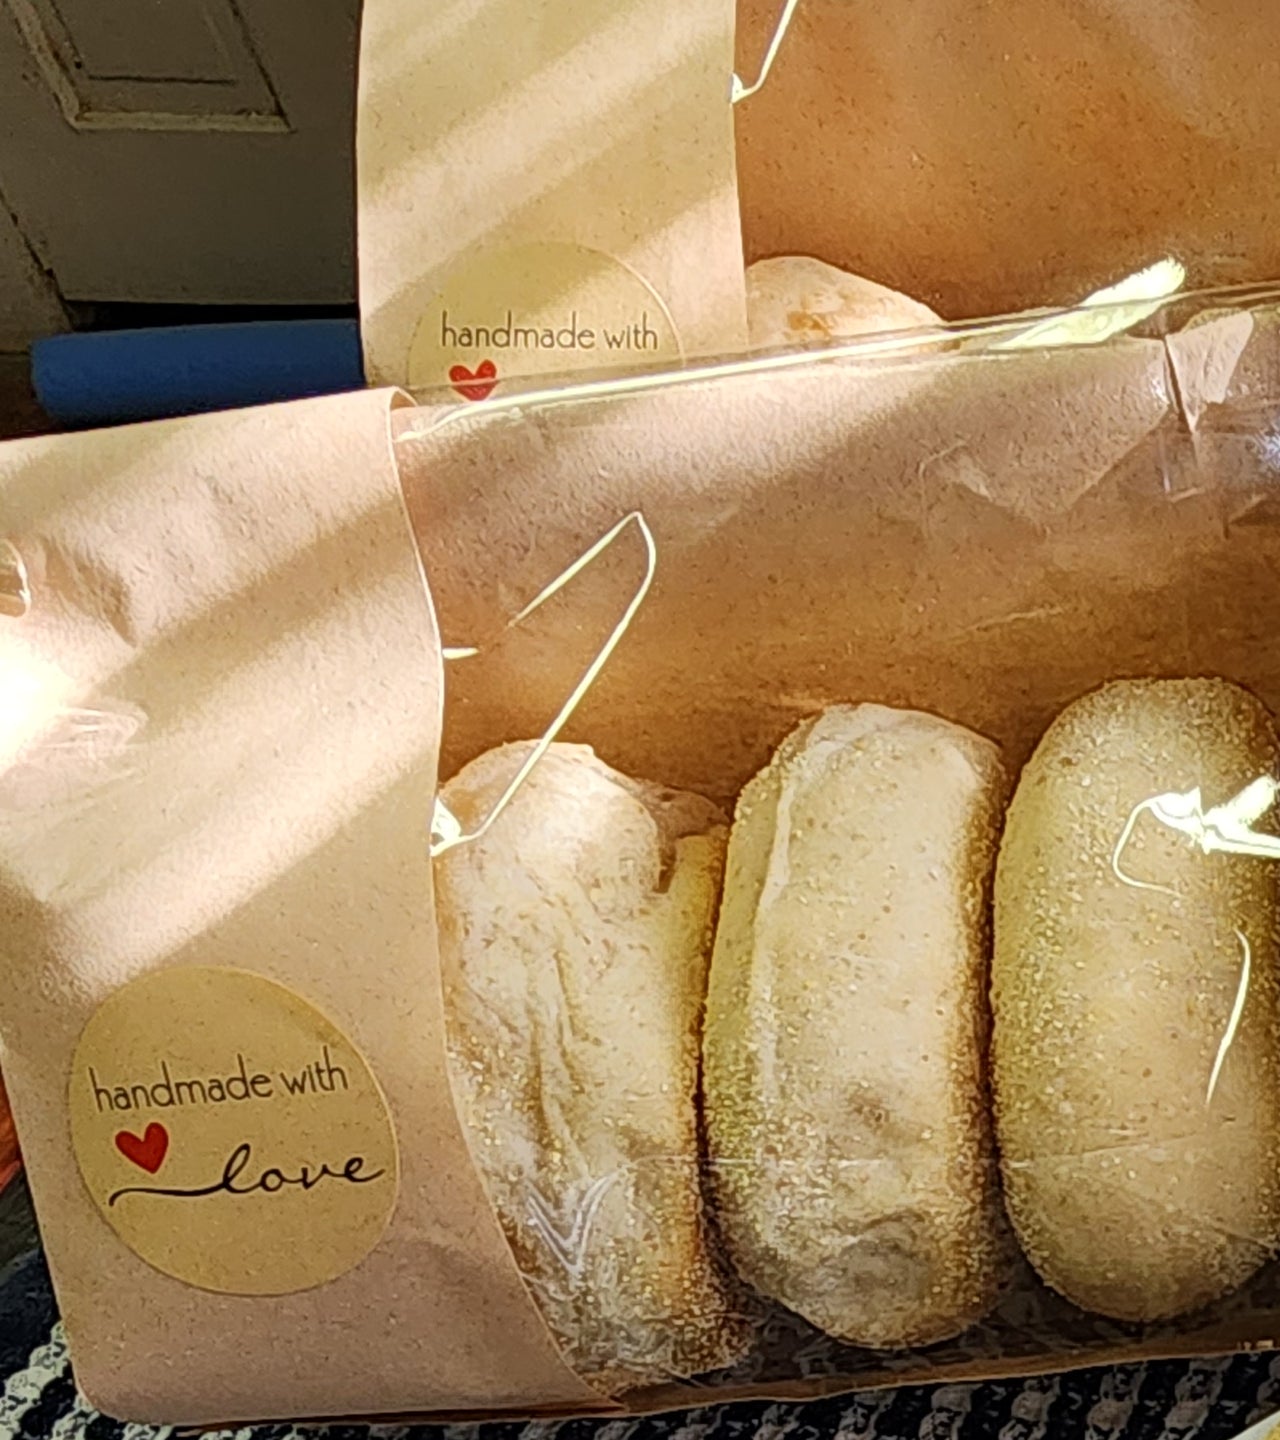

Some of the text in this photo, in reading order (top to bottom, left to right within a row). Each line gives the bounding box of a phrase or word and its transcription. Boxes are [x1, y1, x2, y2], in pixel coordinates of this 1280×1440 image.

[441, 310, 658, 350] handmade with
[89, 1045, 348, 1112] handmade with
[108, 1143, 386, 1207] love
